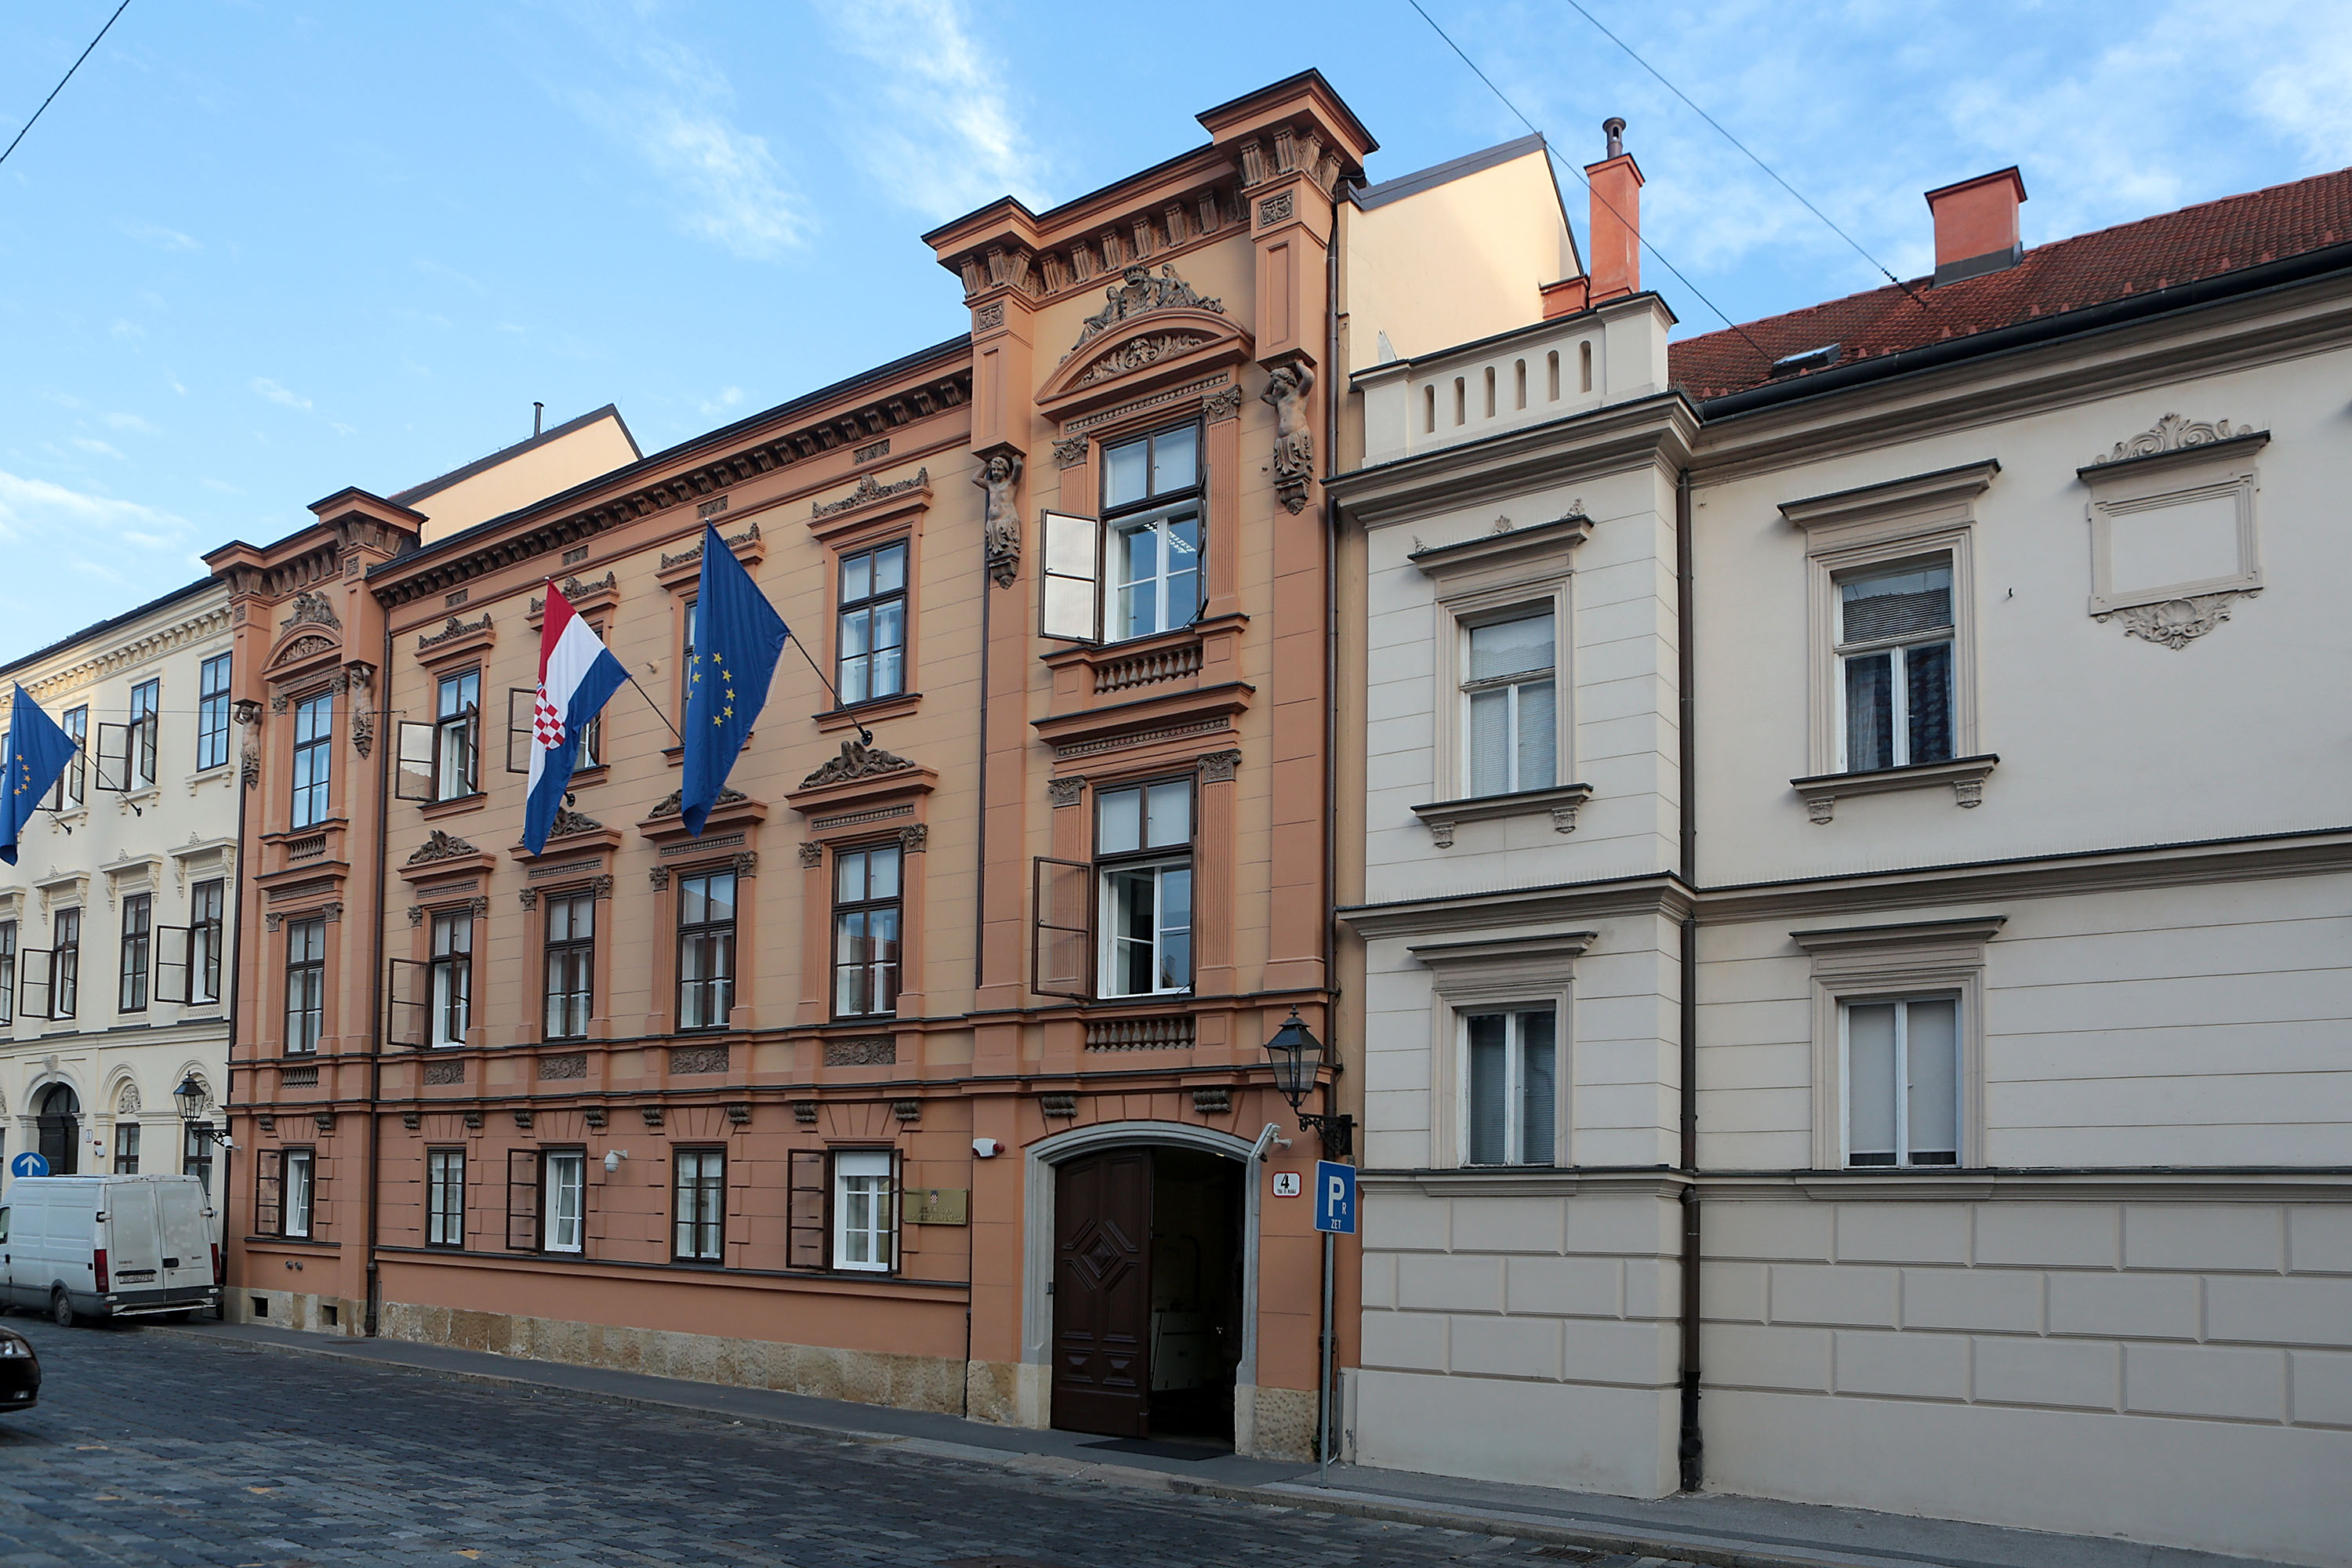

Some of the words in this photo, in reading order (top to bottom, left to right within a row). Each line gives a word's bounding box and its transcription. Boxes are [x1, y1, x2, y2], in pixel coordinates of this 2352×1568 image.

[1281, 1173, 1290, 1189] 4
[1328, 1176, 1345, 1217] P
[1342, 1202, 1347, 1214] R
[1331, 1219, 1341, 1229] ZET
